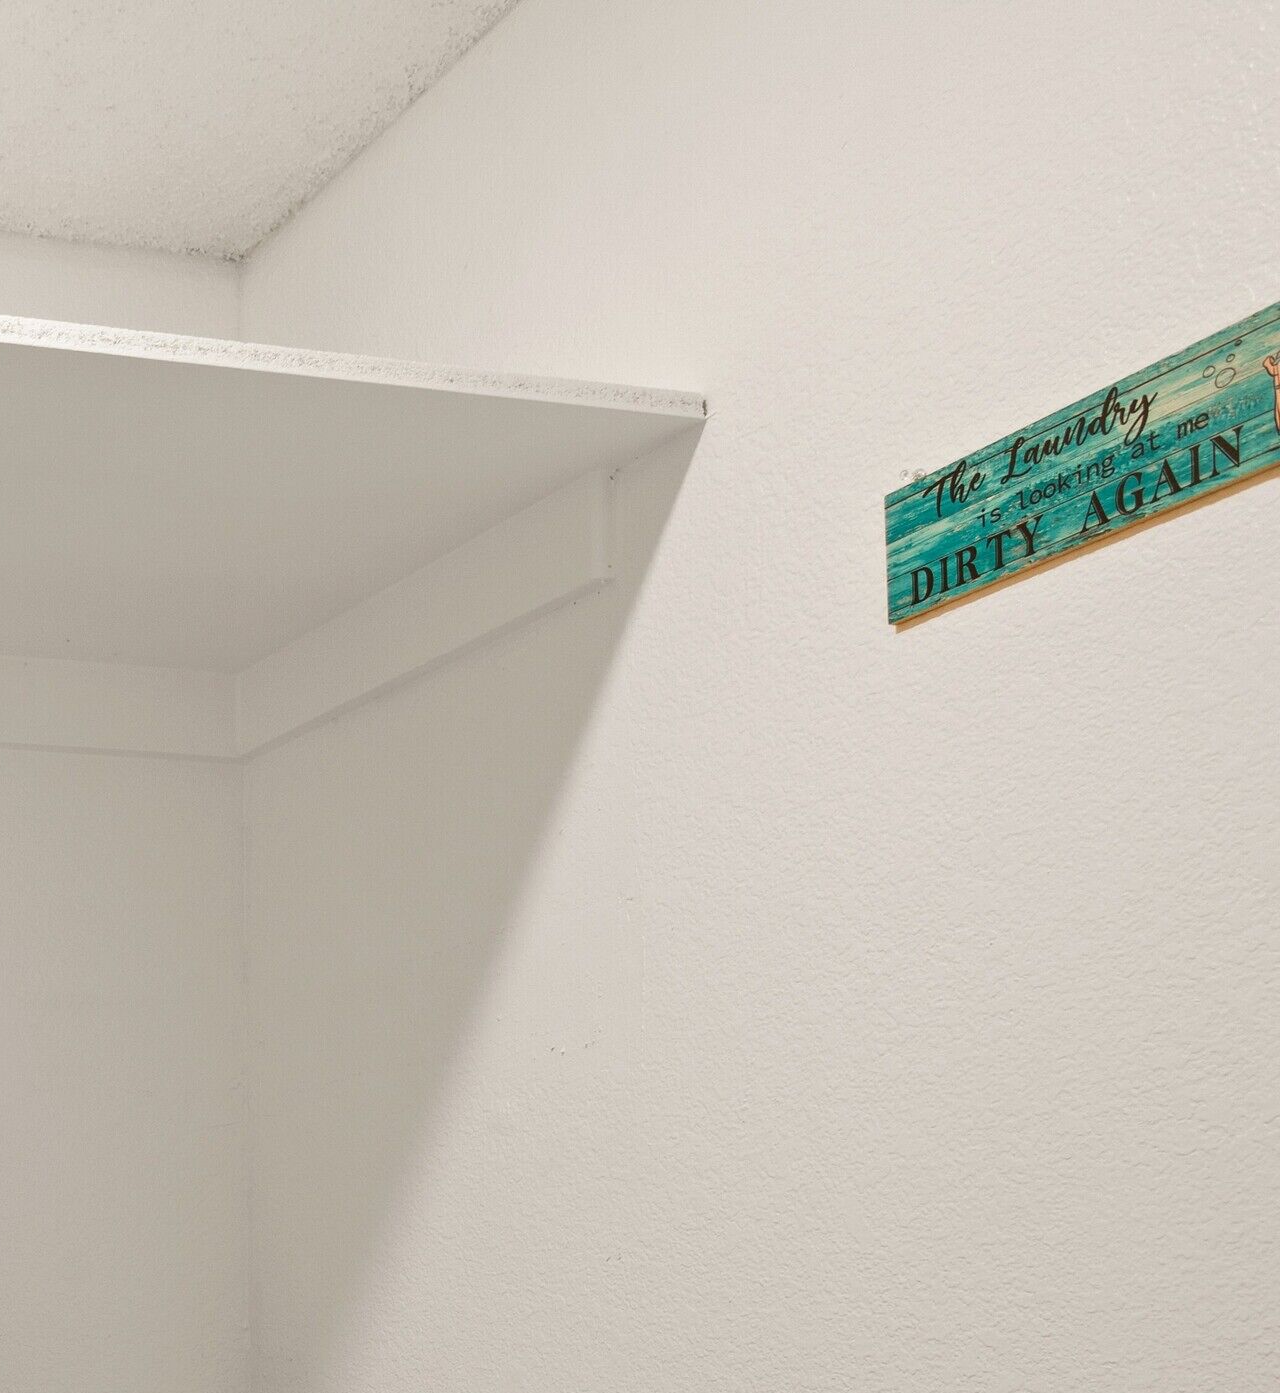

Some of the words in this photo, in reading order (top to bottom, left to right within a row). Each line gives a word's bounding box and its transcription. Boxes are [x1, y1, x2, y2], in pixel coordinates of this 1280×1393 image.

[909, 514, 1044, 607] DIRTY
[1080, 424, 1244, 534] AGAIN
[921, 459, 987, 519] The
[1001, 386, 1159, 485] Laundry
[977, 508, 1002, 528] is
[1016, 453, 1116, 509] looking
[1131, 431, 1163, 460] at
[1176, 411, 1210, 439] me
